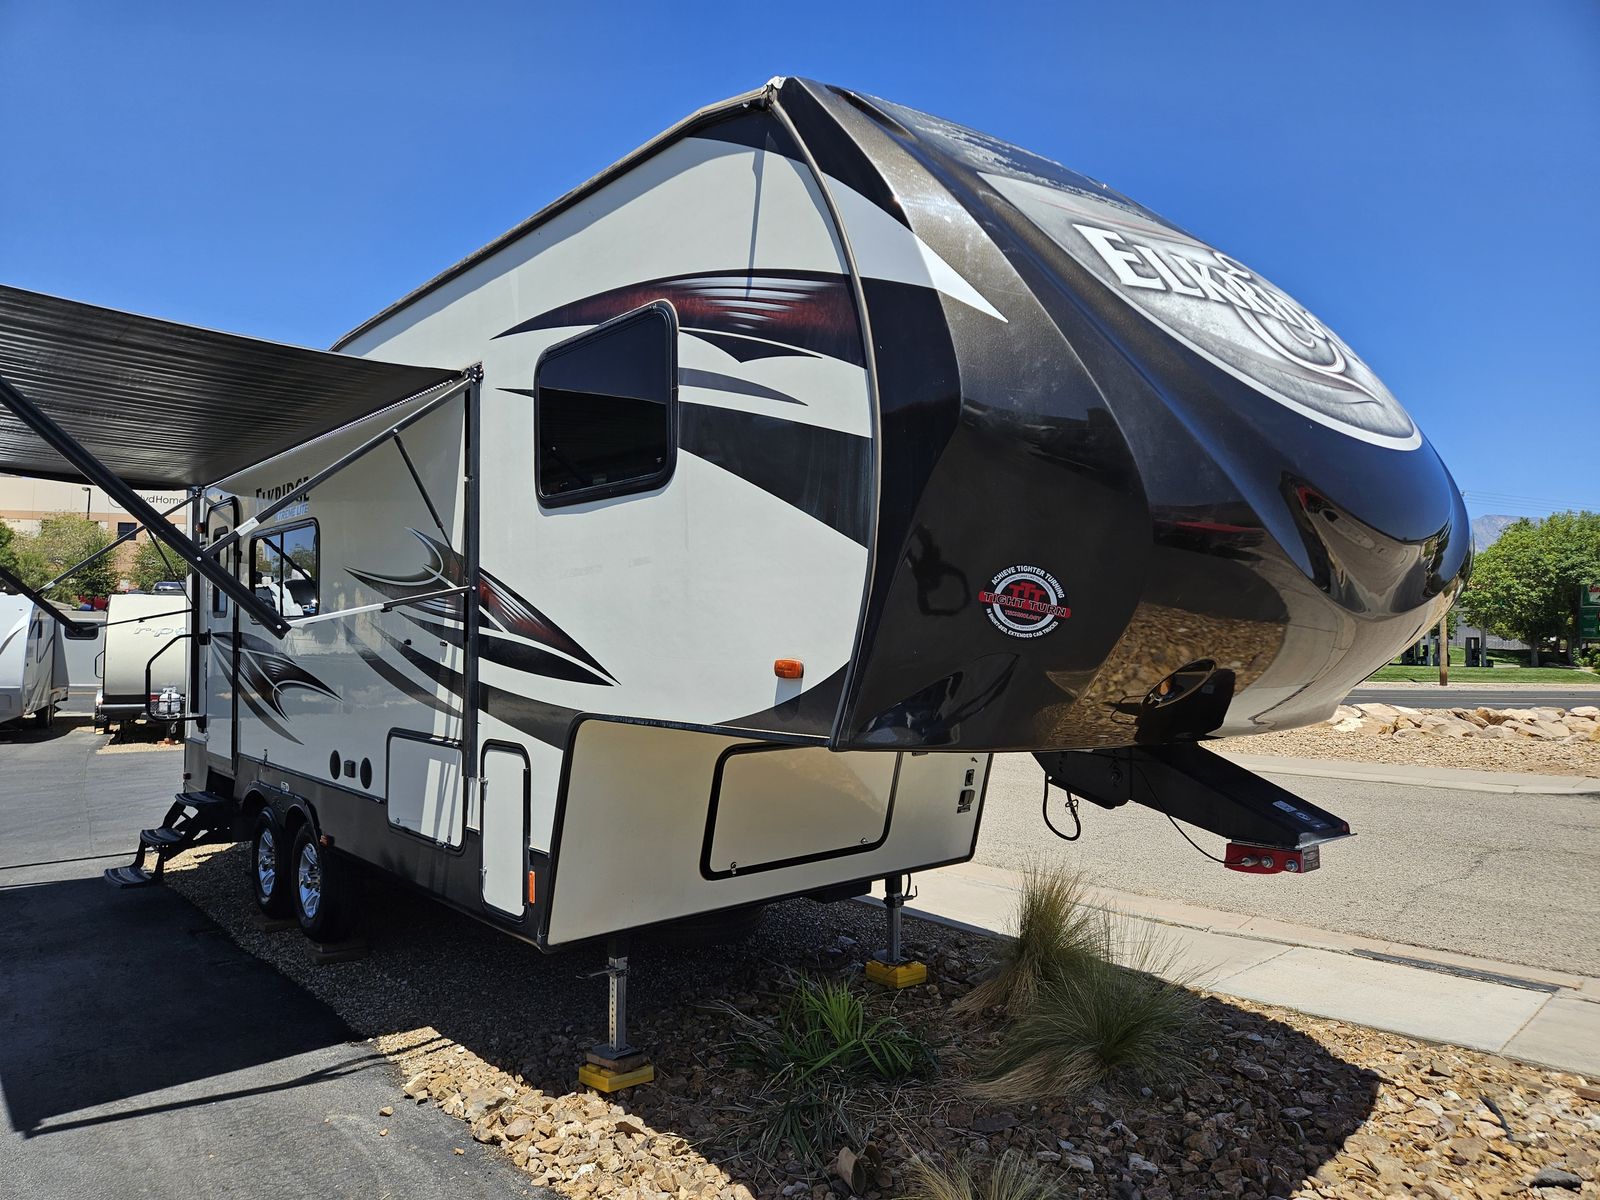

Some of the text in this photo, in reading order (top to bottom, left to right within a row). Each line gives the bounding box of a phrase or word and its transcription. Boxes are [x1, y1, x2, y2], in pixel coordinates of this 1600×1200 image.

[992, 566, 1016, 585] ACHIEVE
[1016, 565, 1046, 576] TIGHTER
[1045, 572, 1065, 599] TURNING
[984, 592, 1067, 617] TIGHT TURN
[1007, 630, 1033, 638] EXTENDED
[1033, 630, 1044, 638] CAB
[1042, 620, 1059, 634] TRUCKS
